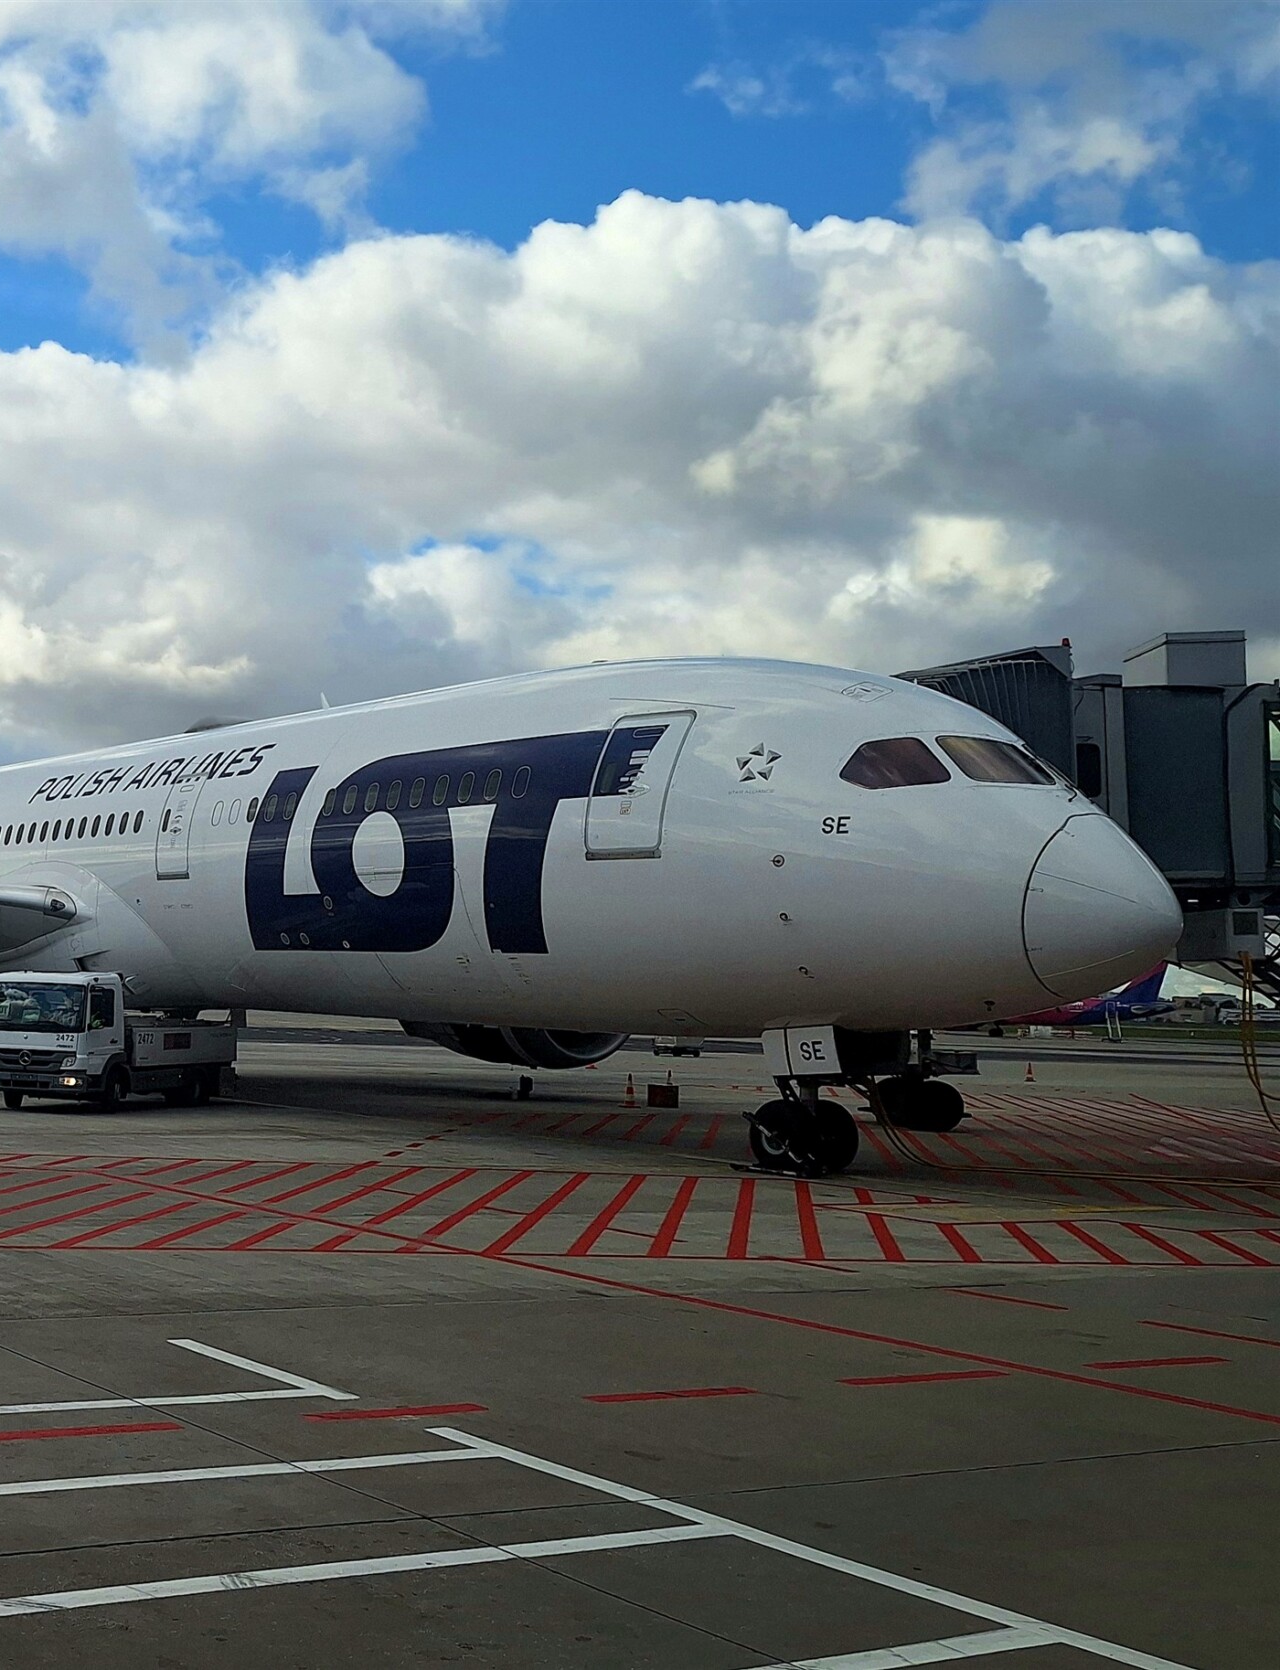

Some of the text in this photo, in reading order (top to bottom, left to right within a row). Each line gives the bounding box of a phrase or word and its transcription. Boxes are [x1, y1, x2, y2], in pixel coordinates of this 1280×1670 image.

[27, 743, 278, 804] POLISH AIRLINES
[821, 816, 851, 835] SE
[243, 724, 671, 955] LOT
[55, 1033, 75, 1042] 2472
[137, 1032, 154, 1045] 2472
[800, 1040, 826, 1061] SE
